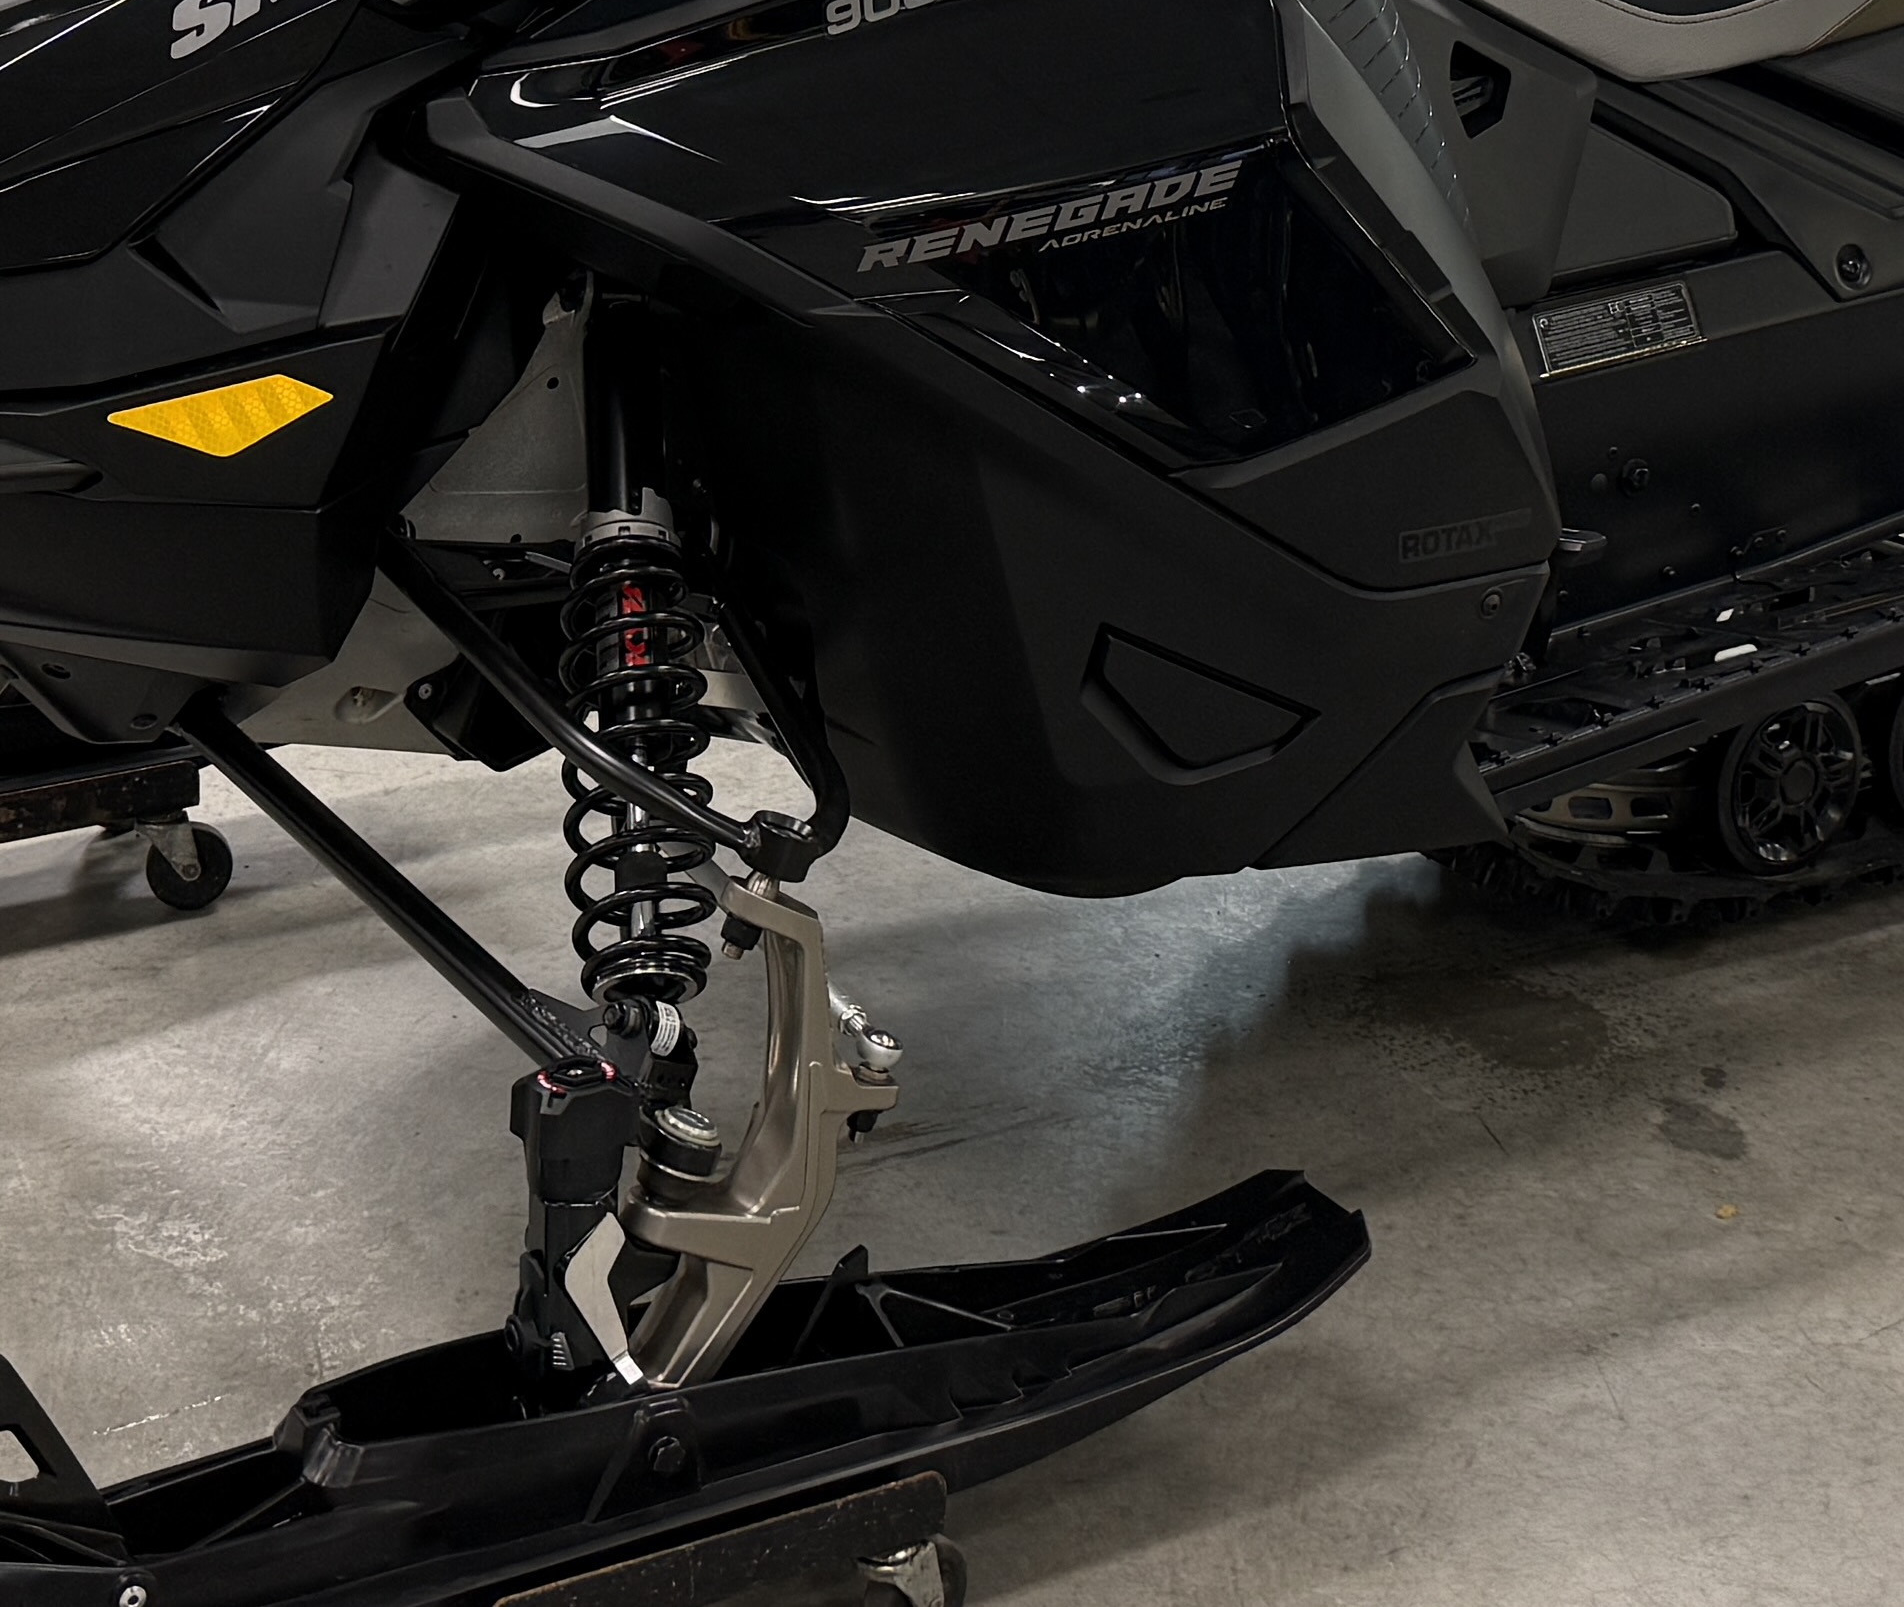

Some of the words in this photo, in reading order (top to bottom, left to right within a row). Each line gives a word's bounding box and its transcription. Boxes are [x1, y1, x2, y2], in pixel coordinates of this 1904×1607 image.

[857, 160, 1243, 272] RENEGADE
[1039, 197, 1229, 252] ADRENALINE
[1402, 521, 1495, 560] ROTAX
